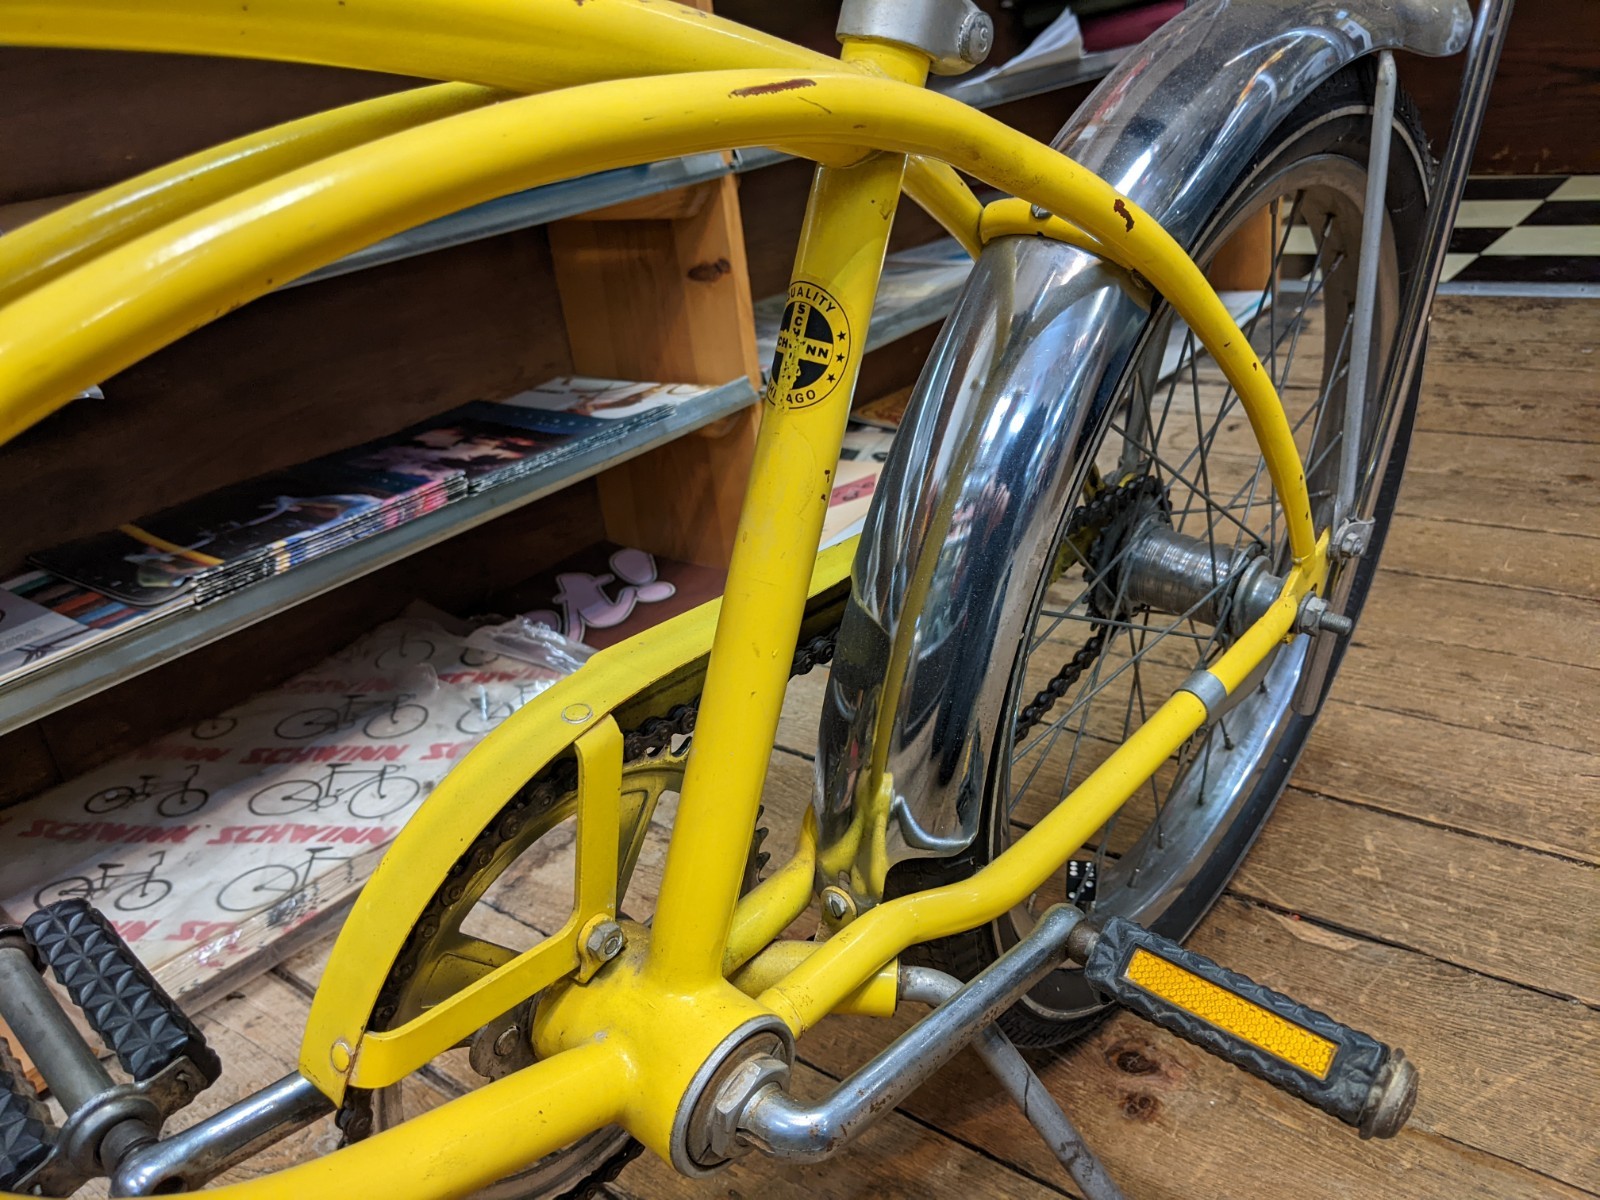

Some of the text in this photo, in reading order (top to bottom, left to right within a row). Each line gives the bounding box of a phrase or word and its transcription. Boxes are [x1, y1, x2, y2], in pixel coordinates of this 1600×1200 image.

[787, 286, 836, 312] UALITY
[768, 383, 816, 404] HIAGO
[238, 744, 411, 765] SCHWINN
[17, 819, 202, 844] SCHWINN
[206, 823, 399, 845] SCHWINN
